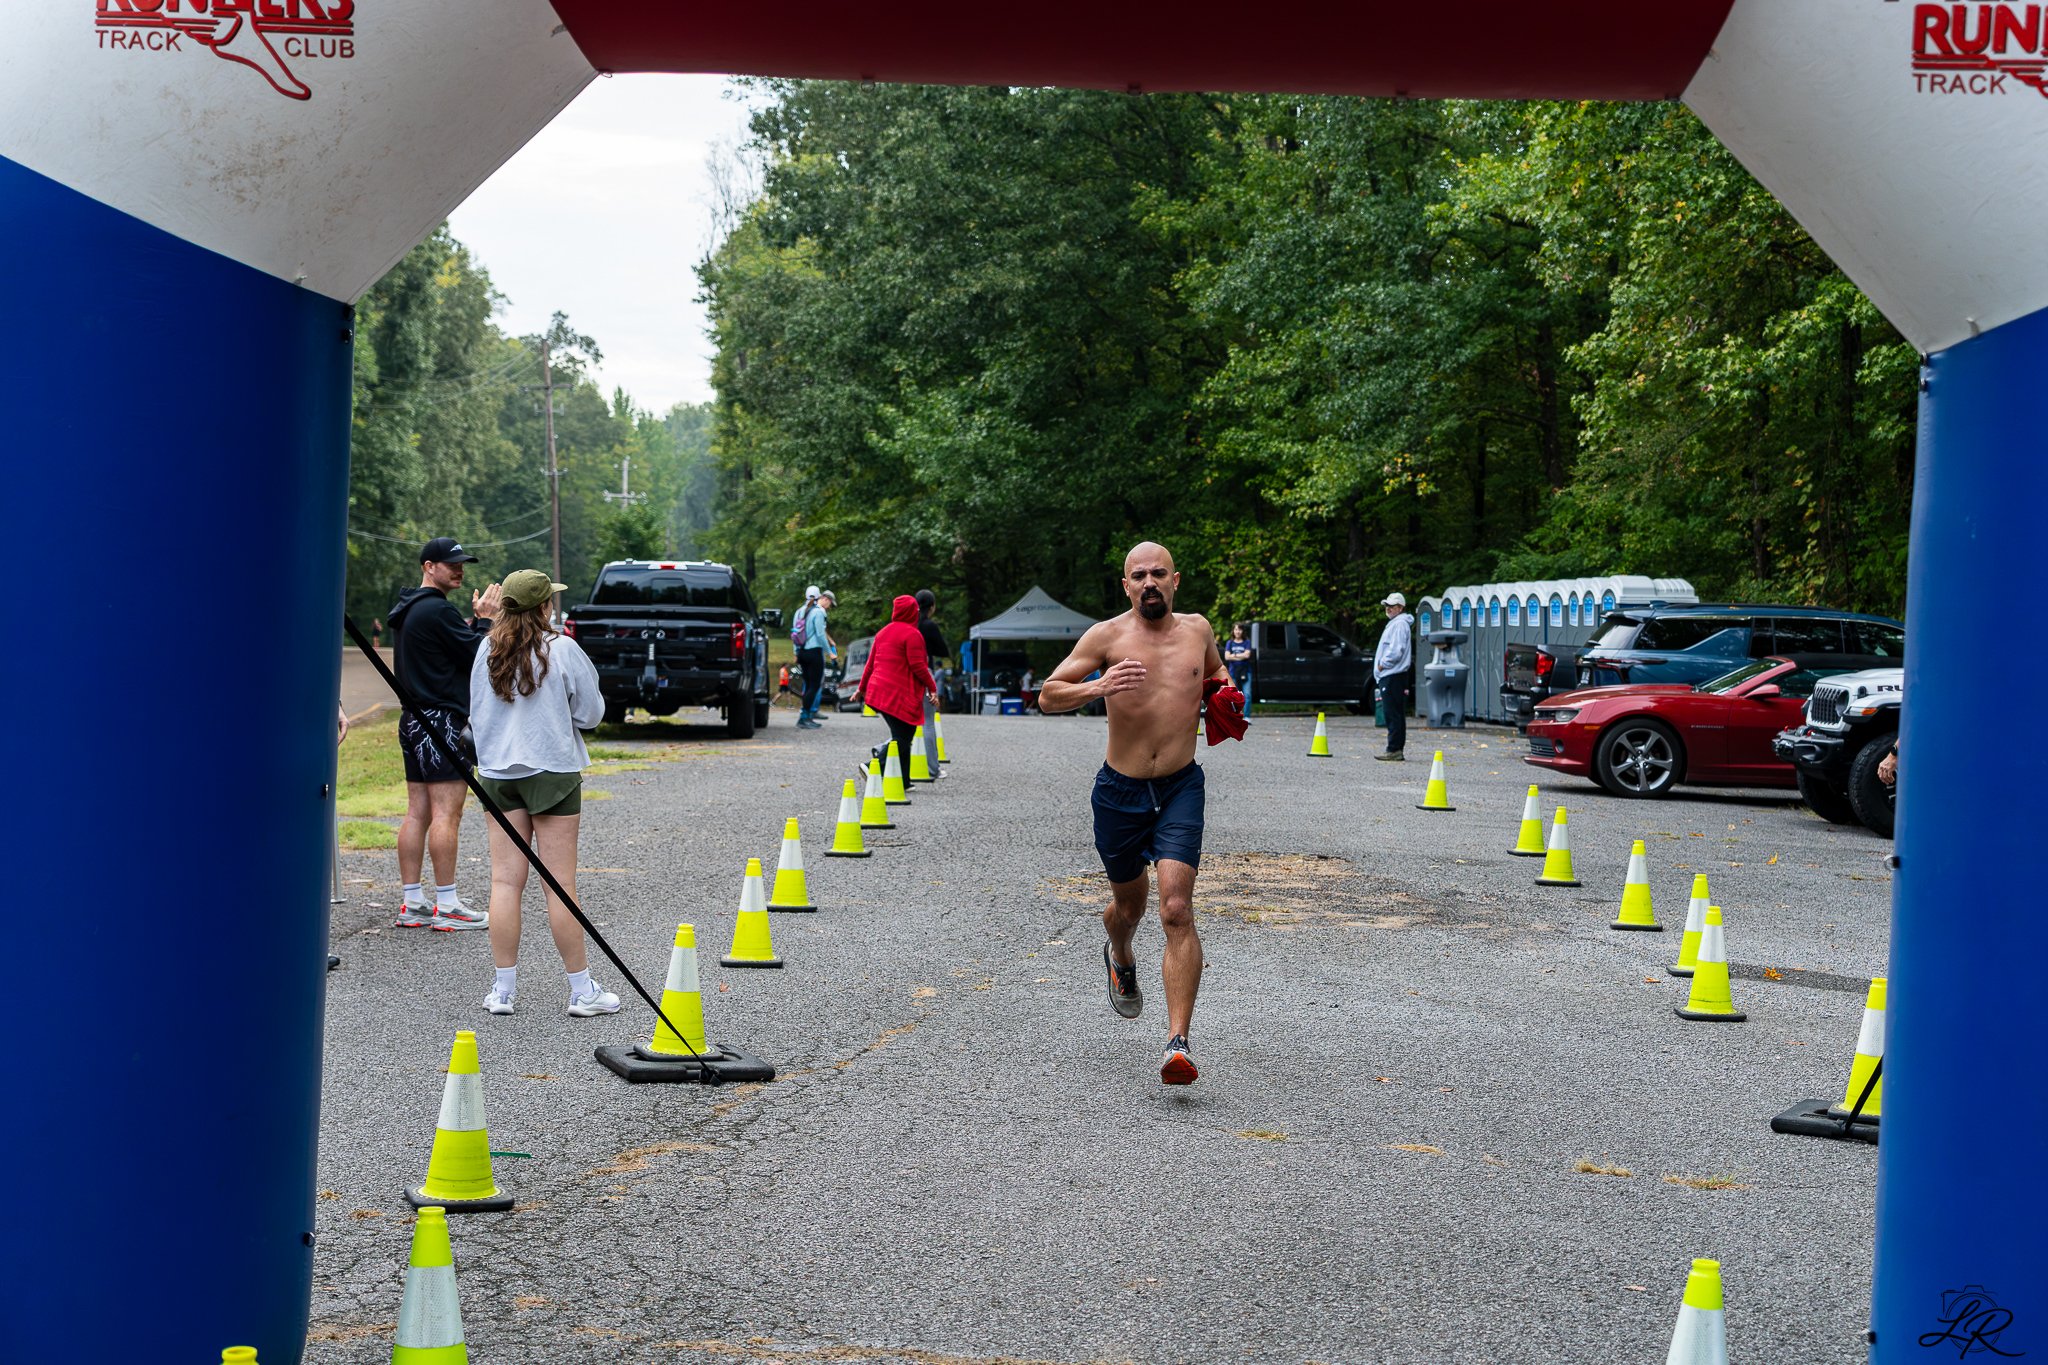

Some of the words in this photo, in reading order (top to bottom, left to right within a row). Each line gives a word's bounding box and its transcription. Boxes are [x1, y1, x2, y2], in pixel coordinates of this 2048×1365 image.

[1912, 4, 2048, 55] RUN
[95, 30, 181, 52] TRACK
[284, 36, 355, 58] CLUB
[1912, 73, 2007, 95] TRACK
